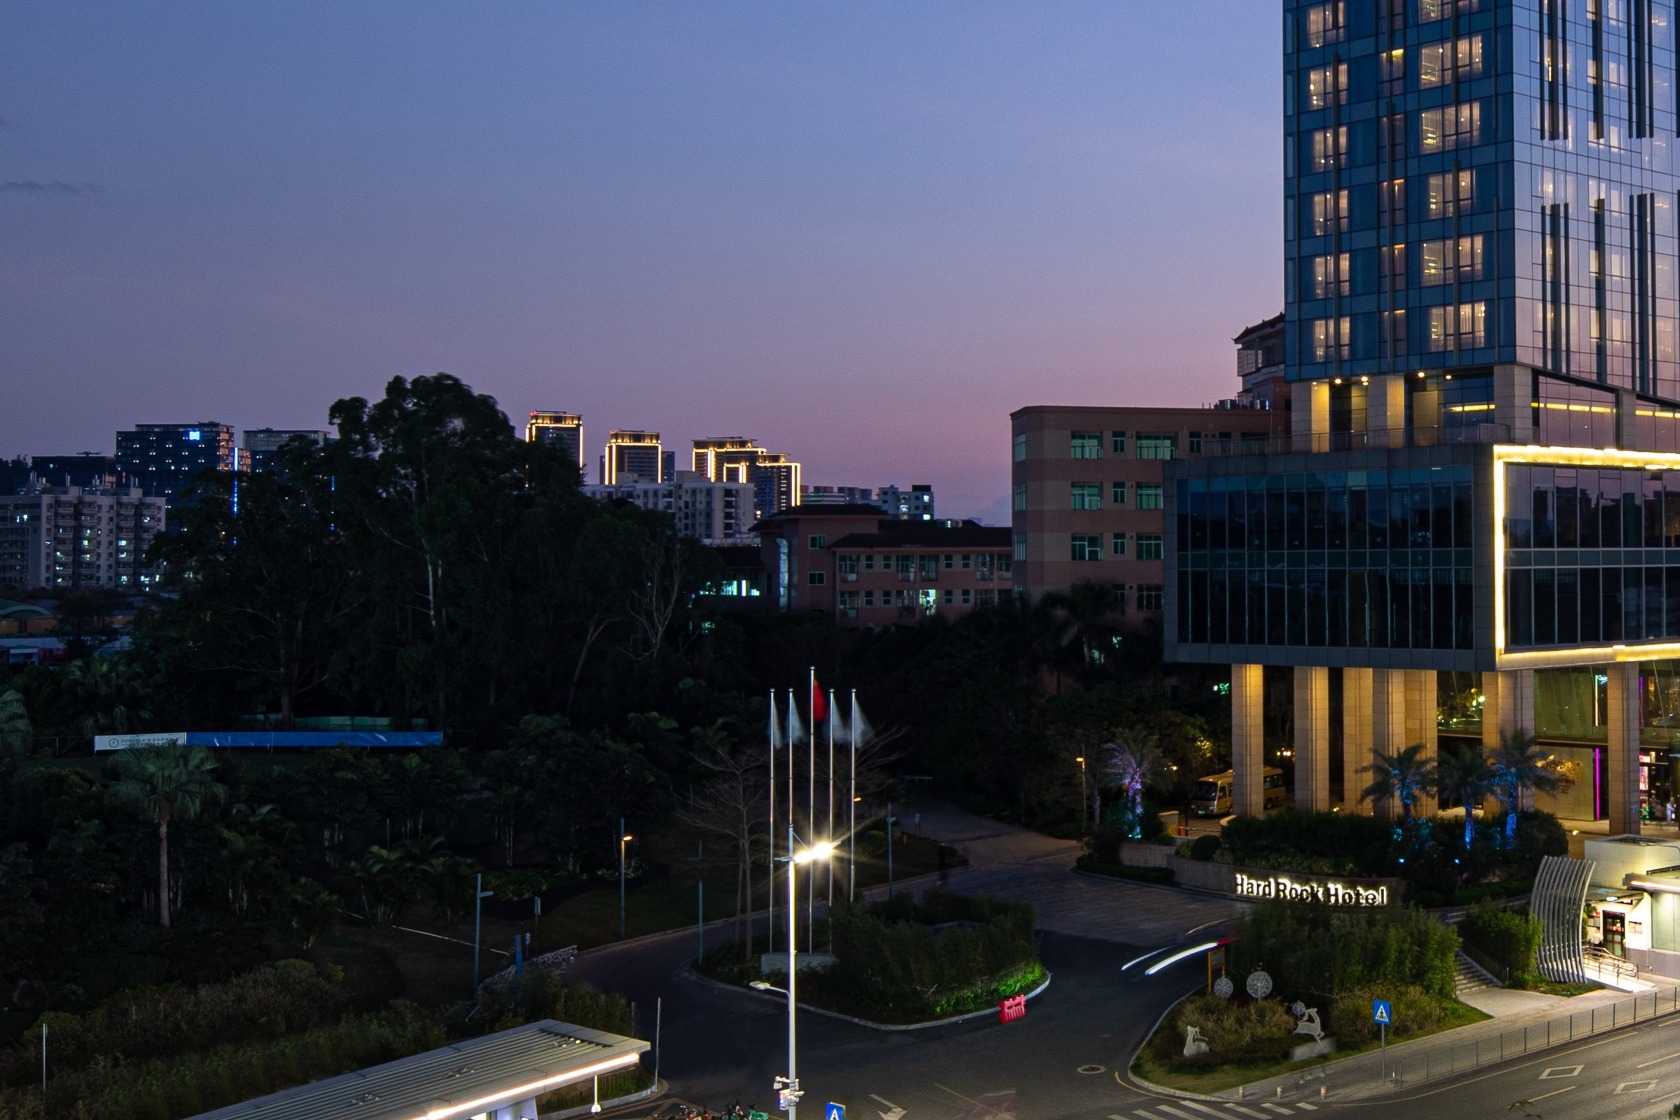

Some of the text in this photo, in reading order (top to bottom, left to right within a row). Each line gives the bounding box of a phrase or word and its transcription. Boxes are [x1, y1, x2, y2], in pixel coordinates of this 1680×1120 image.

[1235, 874, 1388, 907] Hard Rock Hotel
